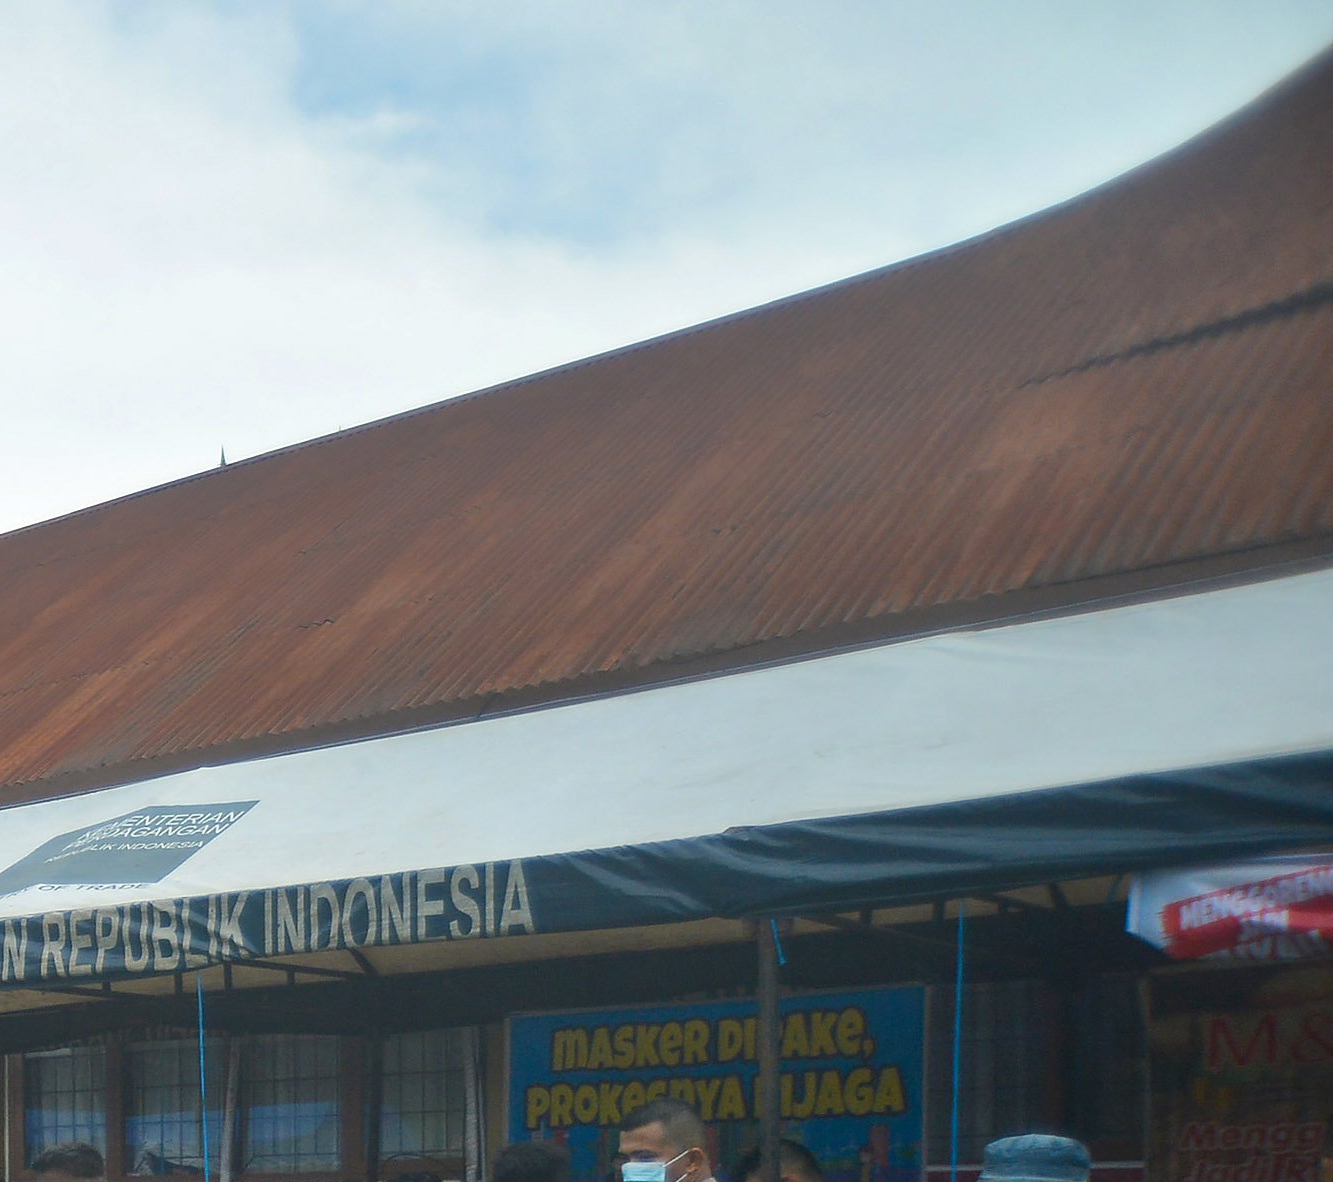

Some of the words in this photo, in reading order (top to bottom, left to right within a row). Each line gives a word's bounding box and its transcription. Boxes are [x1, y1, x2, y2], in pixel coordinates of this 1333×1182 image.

[61, 823, 229, 852] AGANGAN
[77, 811, 245, 842] ENTERIAN
[41, 890, 258, 979] REPUBLIK
[264, 857, 534, 957] INDONESIA
[718, 1006, 876, 1063] DIAKE,
